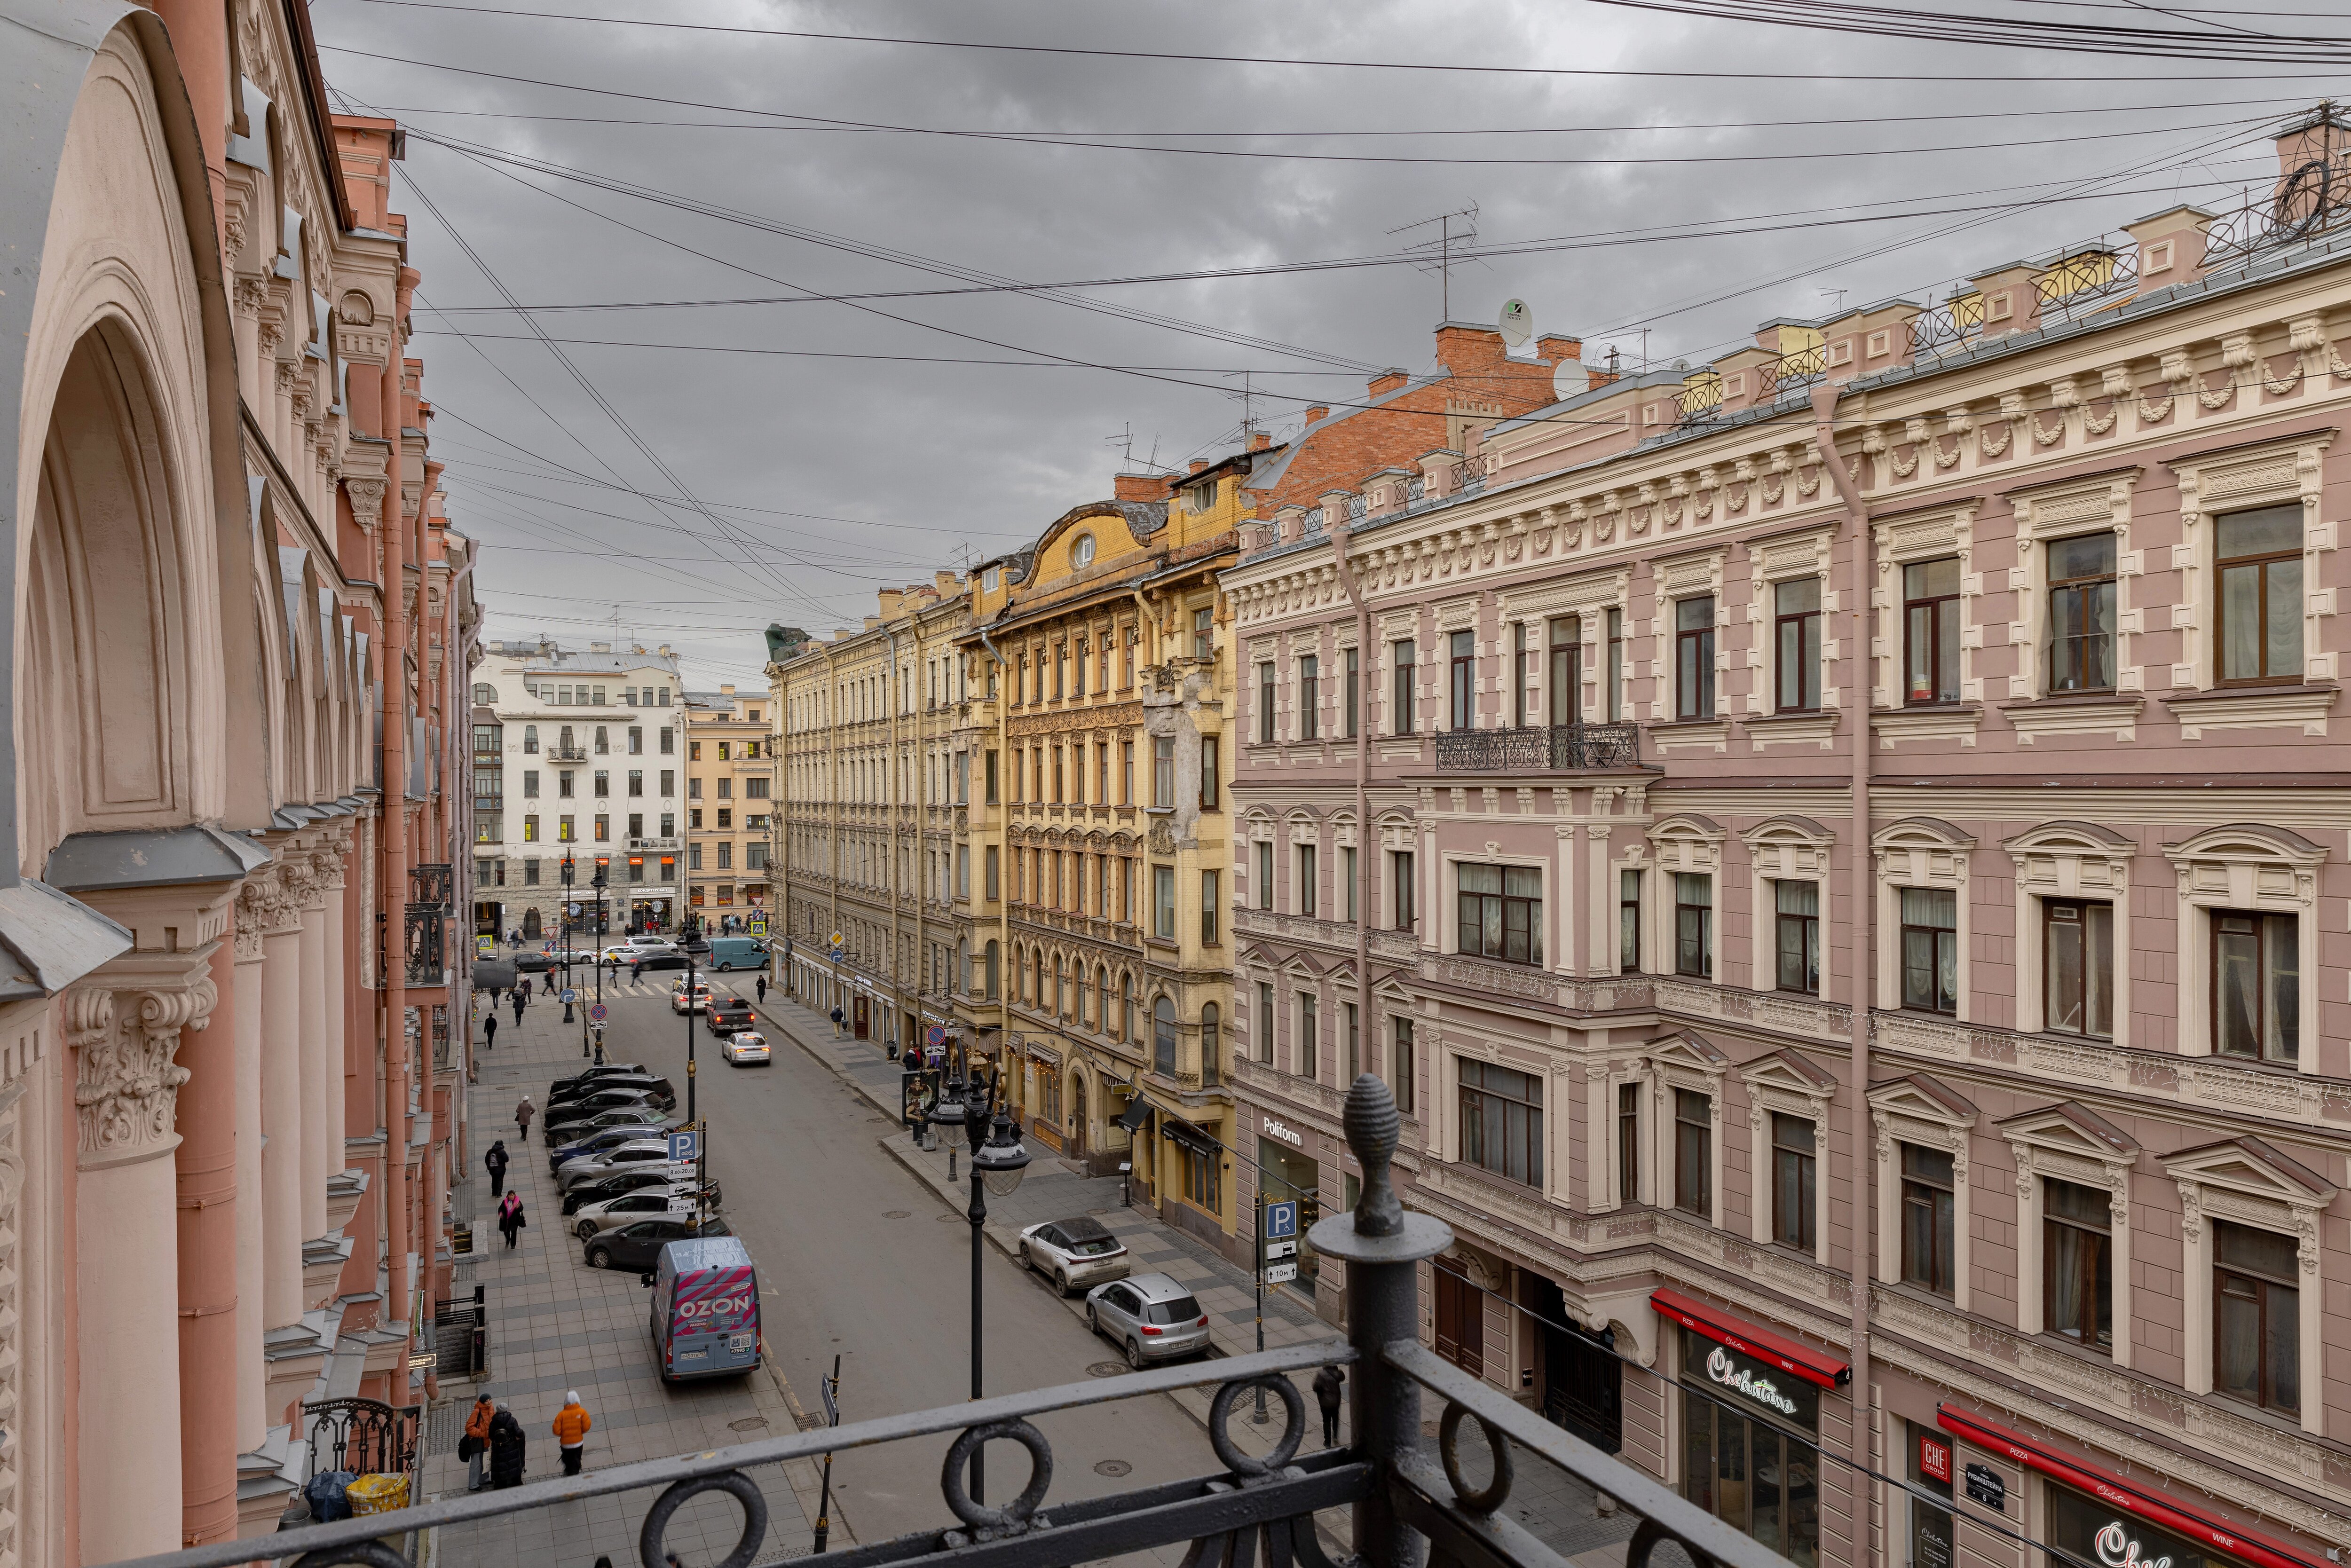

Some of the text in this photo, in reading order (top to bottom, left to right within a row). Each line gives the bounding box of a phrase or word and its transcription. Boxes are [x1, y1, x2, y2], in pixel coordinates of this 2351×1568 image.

[1264, 1117, 1301, 1146] Poliform
[1275, 1206, 1291, 1233] P
[680, 1296, 749, 1317] OZON
[1683, 1317, 1694, 1327] PIZZA
[1725, 1336, 1745, 1350] Chelentano
[1782, 1360, 1793, 1370] WINE
[1707, 1347, 1798, 1414] Chelentano
[1925, 1443, 1945, 1470] CHE
[2010, 1447, 2028, 1460] PIZZA
[1925, 1464, 1945, 1476] GROUP
[1967, 1472, 2003, 1493] РУБИНШТЕЙНА
[2097, 1485, 2130, 1505] Chelentano
[1922, 1527, 1948, 1547] Chelentano
[2213, 1533, 2234, 1548] WINE
